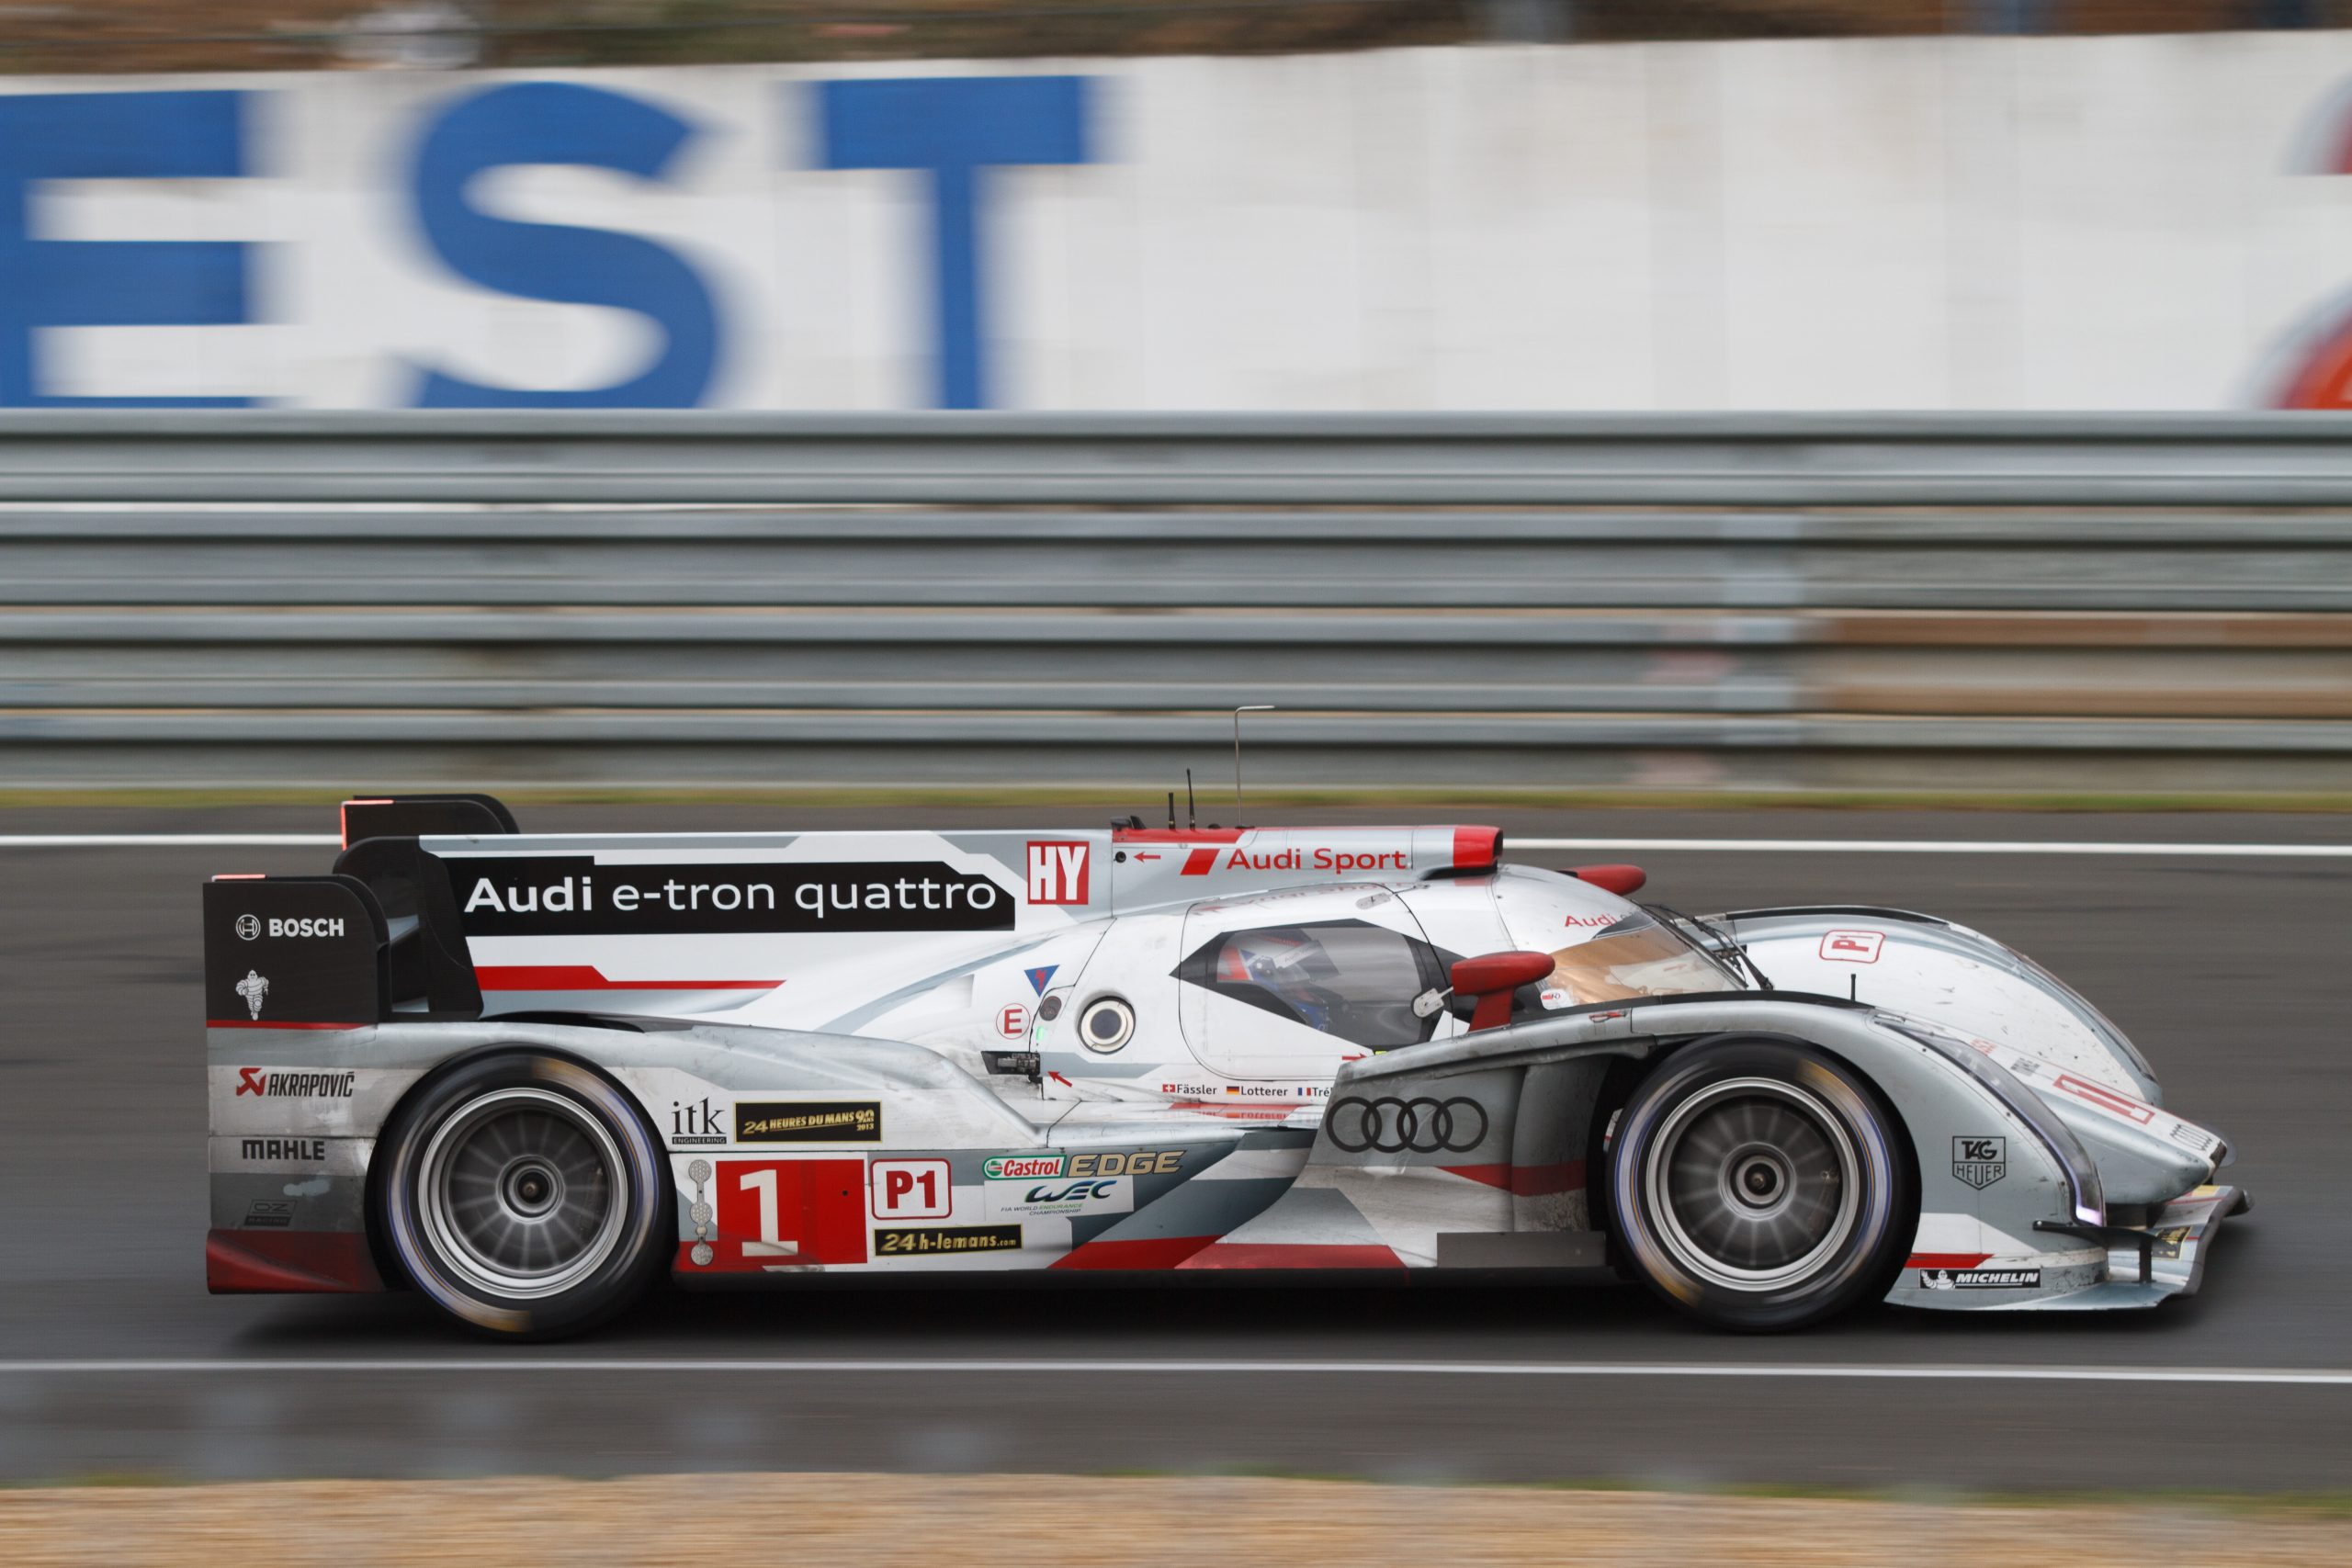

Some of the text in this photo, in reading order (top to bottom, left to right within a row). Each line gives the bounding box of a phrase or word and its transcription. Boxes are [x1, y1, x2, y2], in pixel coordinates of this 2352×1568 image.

[1029, 845, 1086, 901] HY
[1227, 848, 1407, 874] Audi Sport
[464, 876, 997, 918] Audi e-tron quattro
[268, 918, 345, 937] BOSCH
[1003, 1008, 1023, 1034] E
[1177, 1084, 1217, 1095] Fässler
[1241, 1086, 1288, 1097] Lotterer
[671, 1097, 727, 1134] itk
[742, 1120, 769, 1135] 24
[769, 1115, 807, 1130] HEURES
[808, 1113, 824, 1125] DU
[824, 1111, 854, 1124] MANS
[856, 1122, 875, 1131] 2013
[242, 1140, 325, 1160] MAHLE
[1962, 1140, 1997, 1160] TAG
[1003, 1150, 1188, 1179] Castrol EDGE
[1956, 1164, 2002, 1186] HEUER
[886, 1169, 936, 1209] P1
[740, 1169, 798, 1257] 1
[1955, 1272, 2039, 1283] MICHELIN
